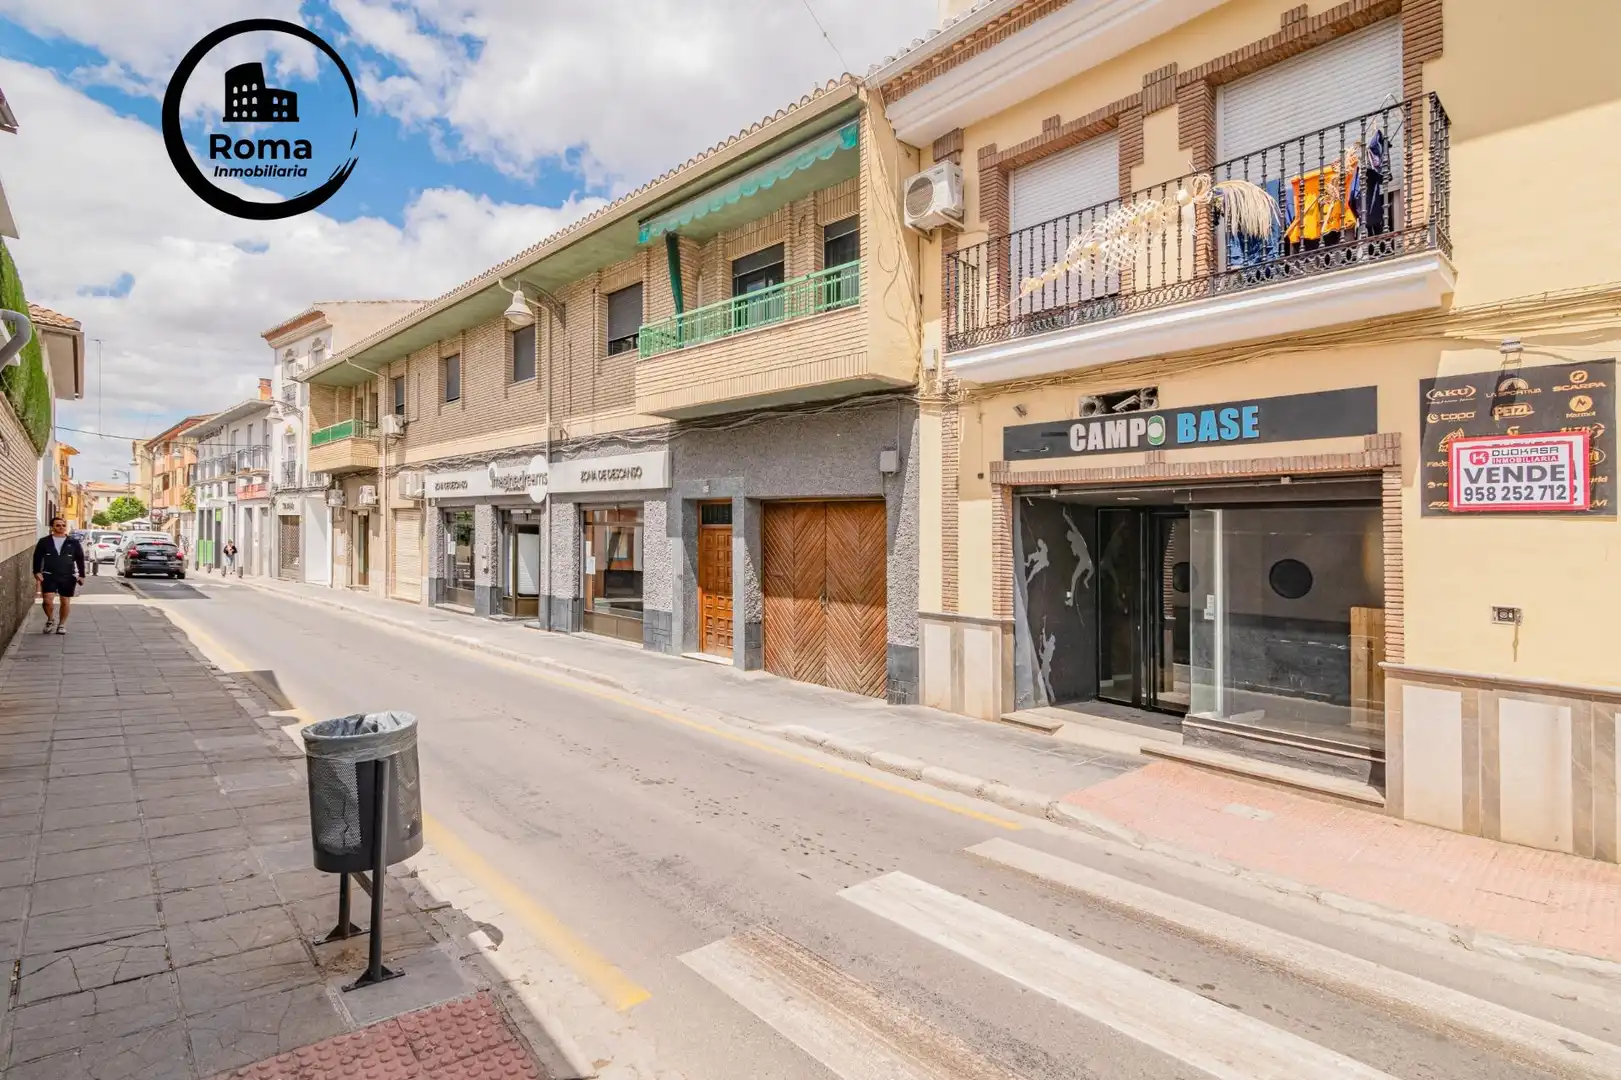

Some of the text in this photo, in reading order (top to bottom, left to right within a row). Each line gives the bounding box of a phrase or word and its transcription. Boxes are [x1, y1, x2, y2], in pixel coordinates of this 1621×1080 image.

[1552, 381, 1607, 392] SCARPA
[1432, 387, 1471, 398] AKU
[1069, 405, 1260, 452] CAMPO BASE
[1492, 446, 1559, 457] DUOKASA
[1492, 455, 1559, 464] INMOBILIARIA
[1463, 464, 1566, 485] VENDE
[1463, 484, 1567, 502] 958 252 712
